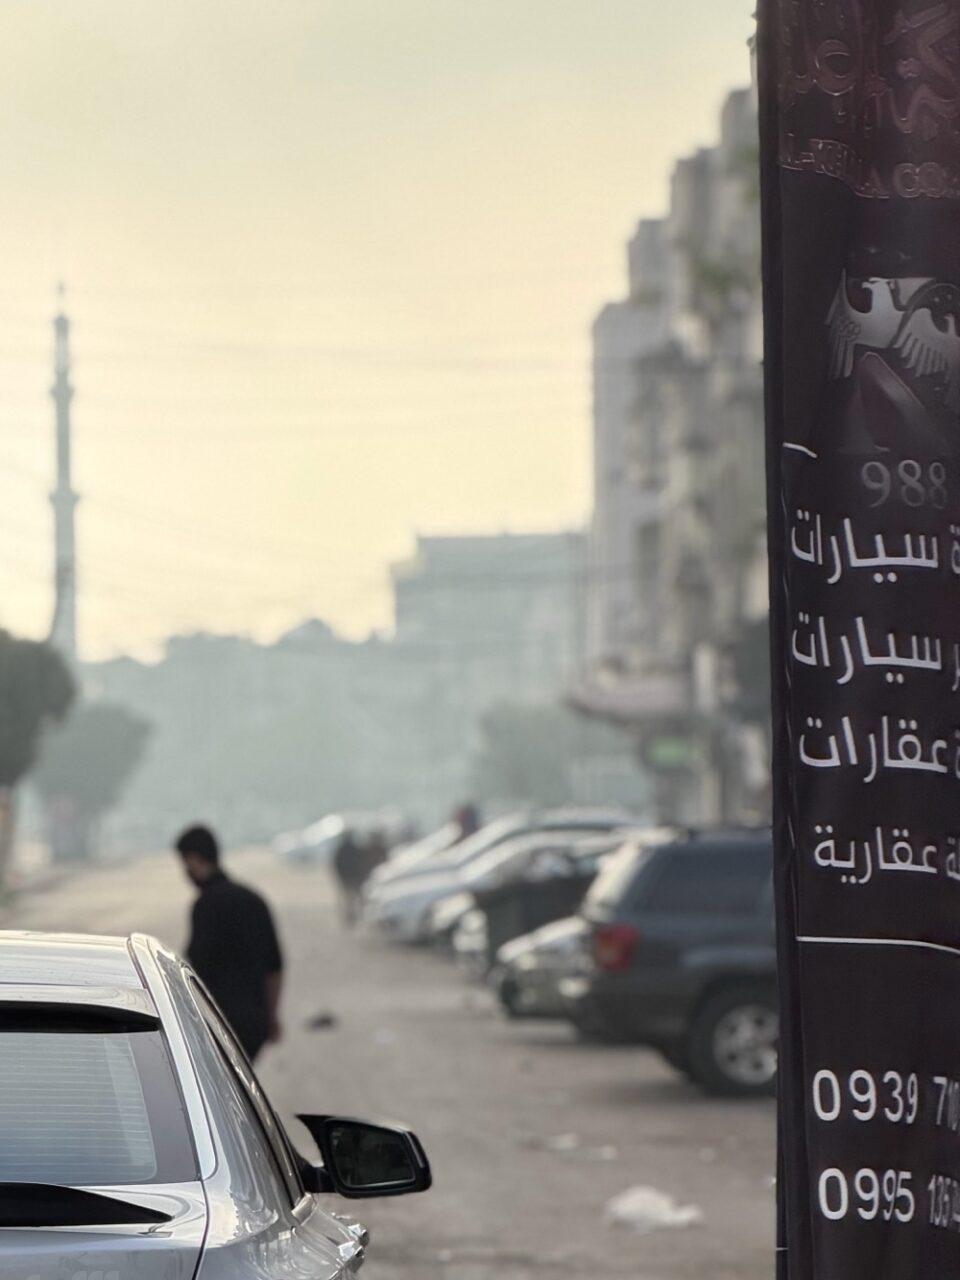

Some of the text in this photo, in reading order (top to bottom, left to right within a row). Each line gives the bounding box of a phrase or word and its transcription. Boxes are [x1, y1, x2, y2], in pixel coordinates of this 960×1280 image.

[791, 508, 939, 584] سيارات
[792, 612, 942, 684] سيارات
[799, 715, 948, 783] عقارات
[814, 825, 938, 884] عقارية
[813, 1069, 919, 1125] 0939
[818, 1168, 915, 1222] 0995
